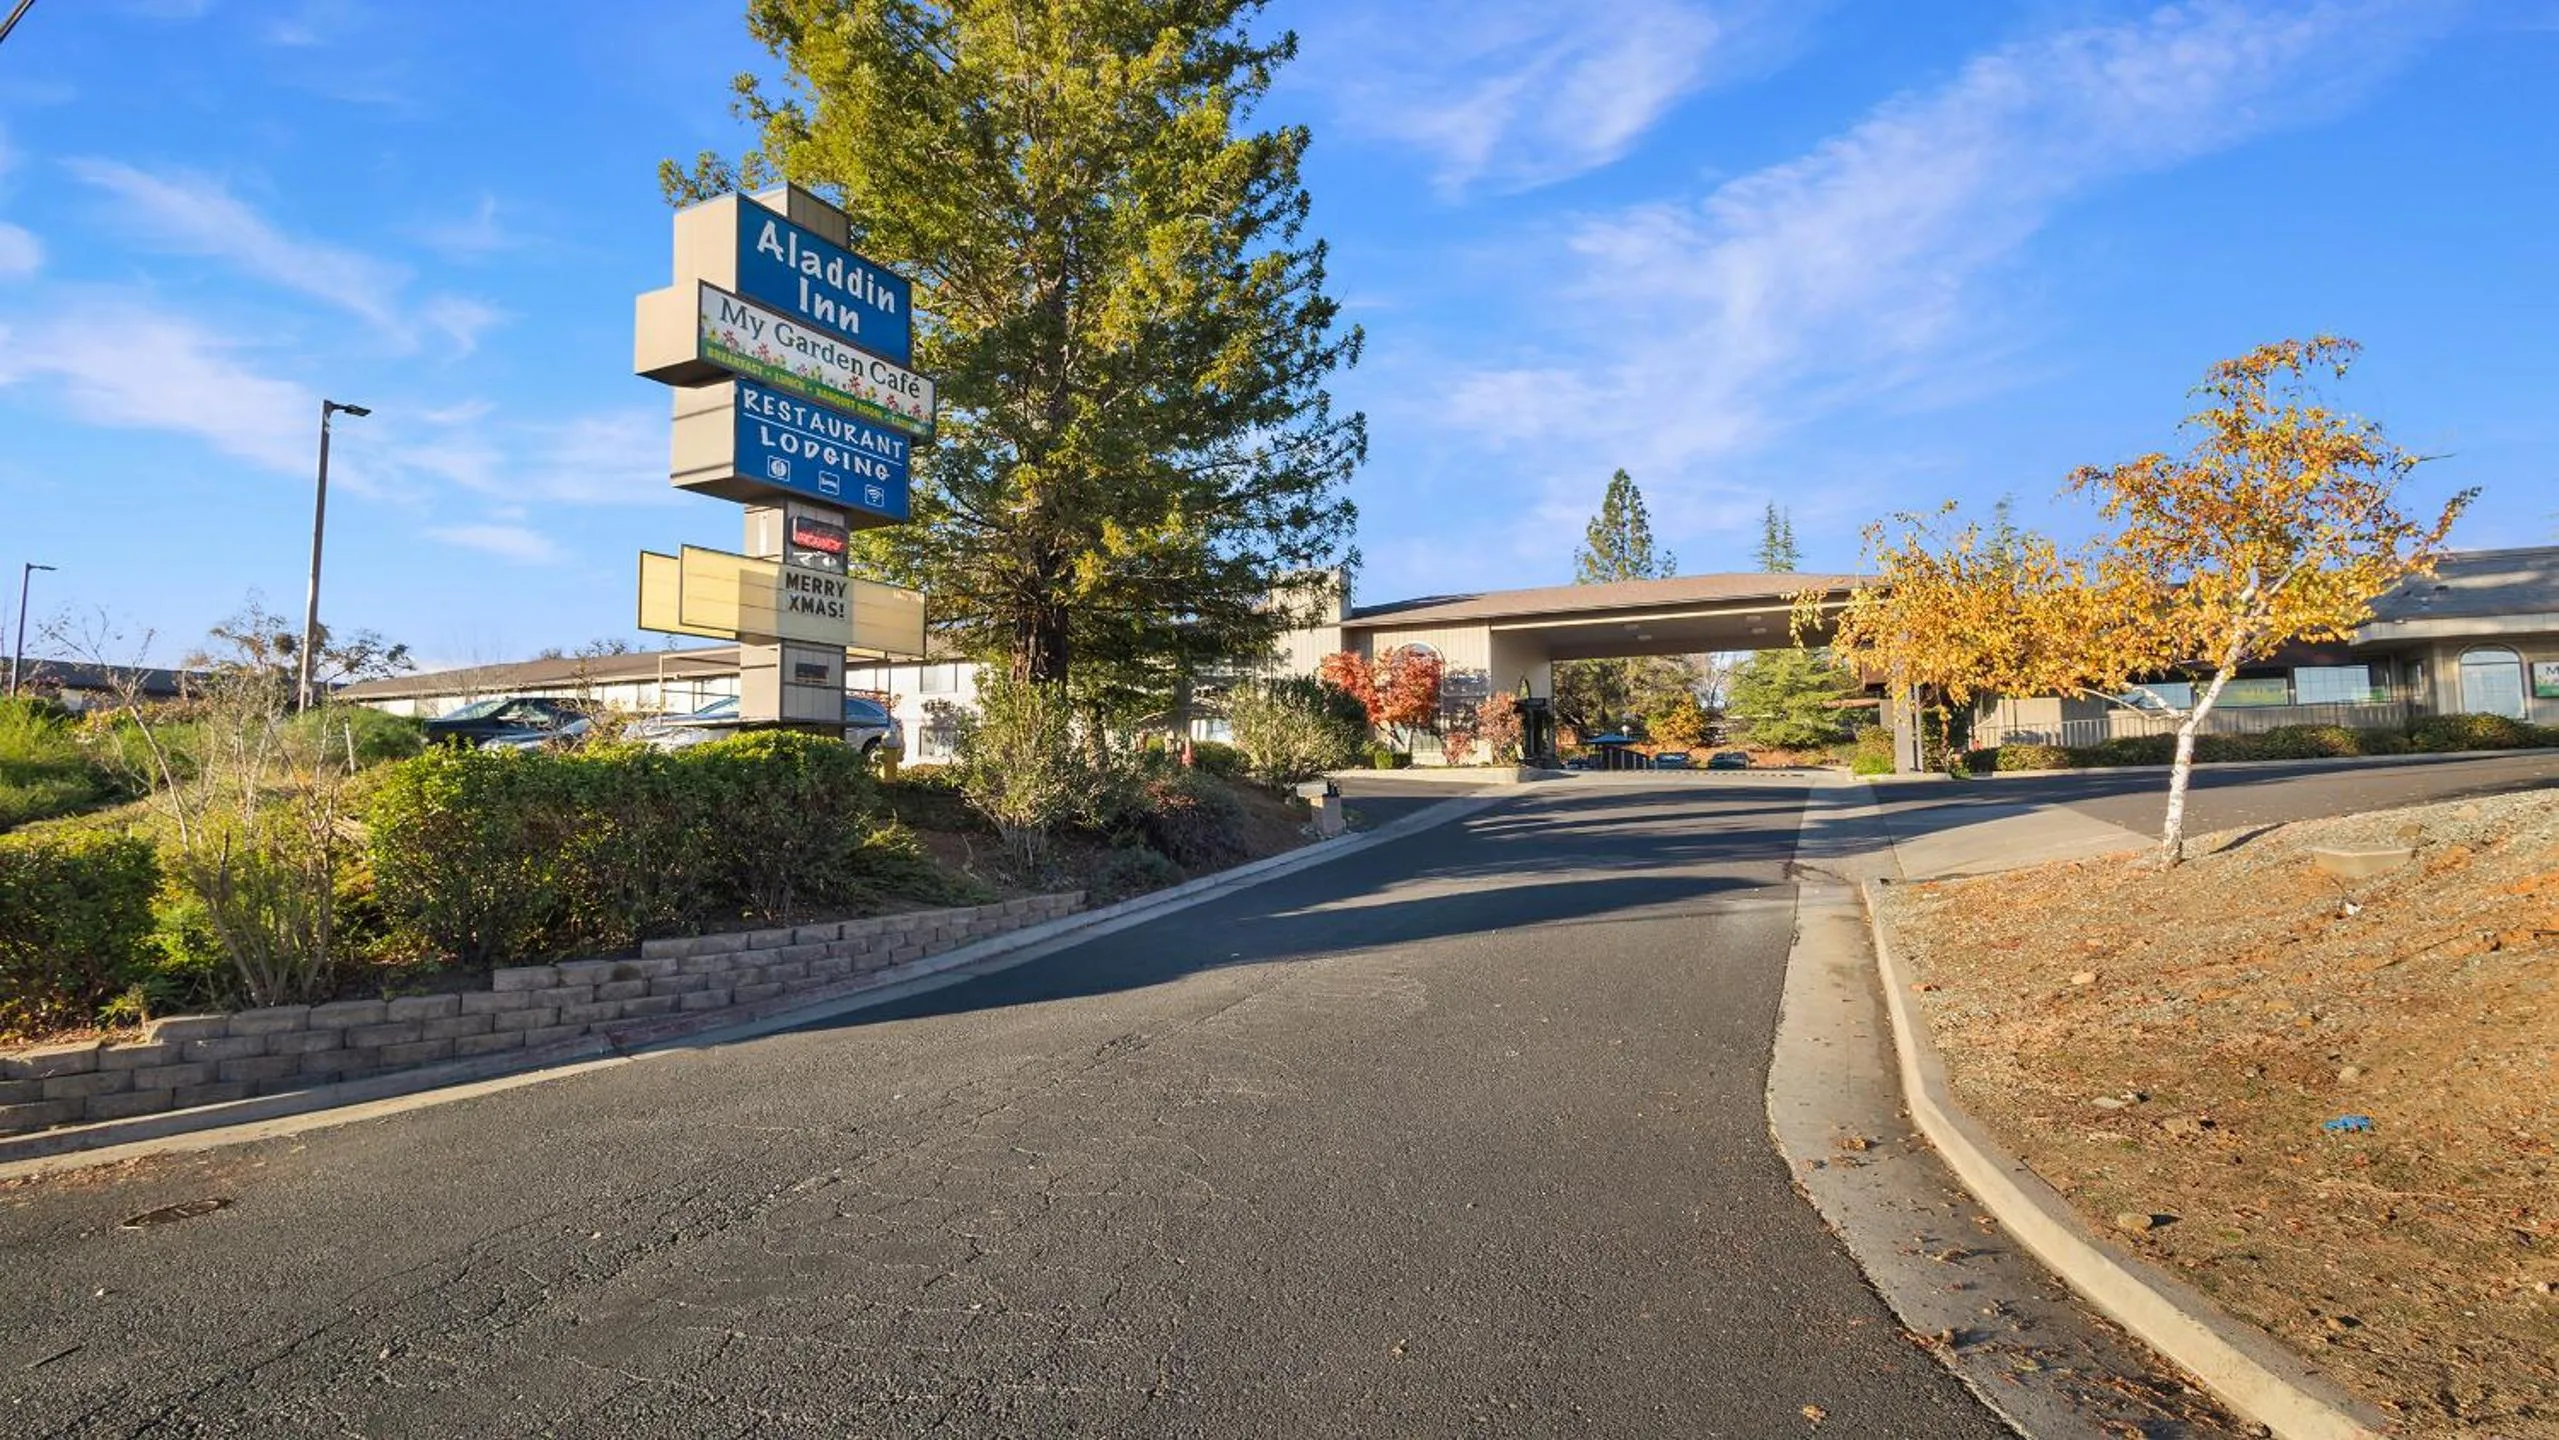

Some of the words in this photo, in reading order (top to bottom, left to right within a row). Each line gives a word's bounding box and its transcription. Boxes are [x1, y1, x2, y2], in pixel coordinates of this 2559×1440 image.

[758, 220, 895, 313] Aladdin
[800, 277, 859, 334] Inn
[721, 297, 765, 340] My
[775, 322, 866, 377] Garden
[870, 361, 921, 398] Café
[744, 388, 903, 458] RESTAURANT
[762, 427, 891, 481] LODGING
[785, 572, 847, 598] MERRY
[789, 596, 845, 619] XMAS!
